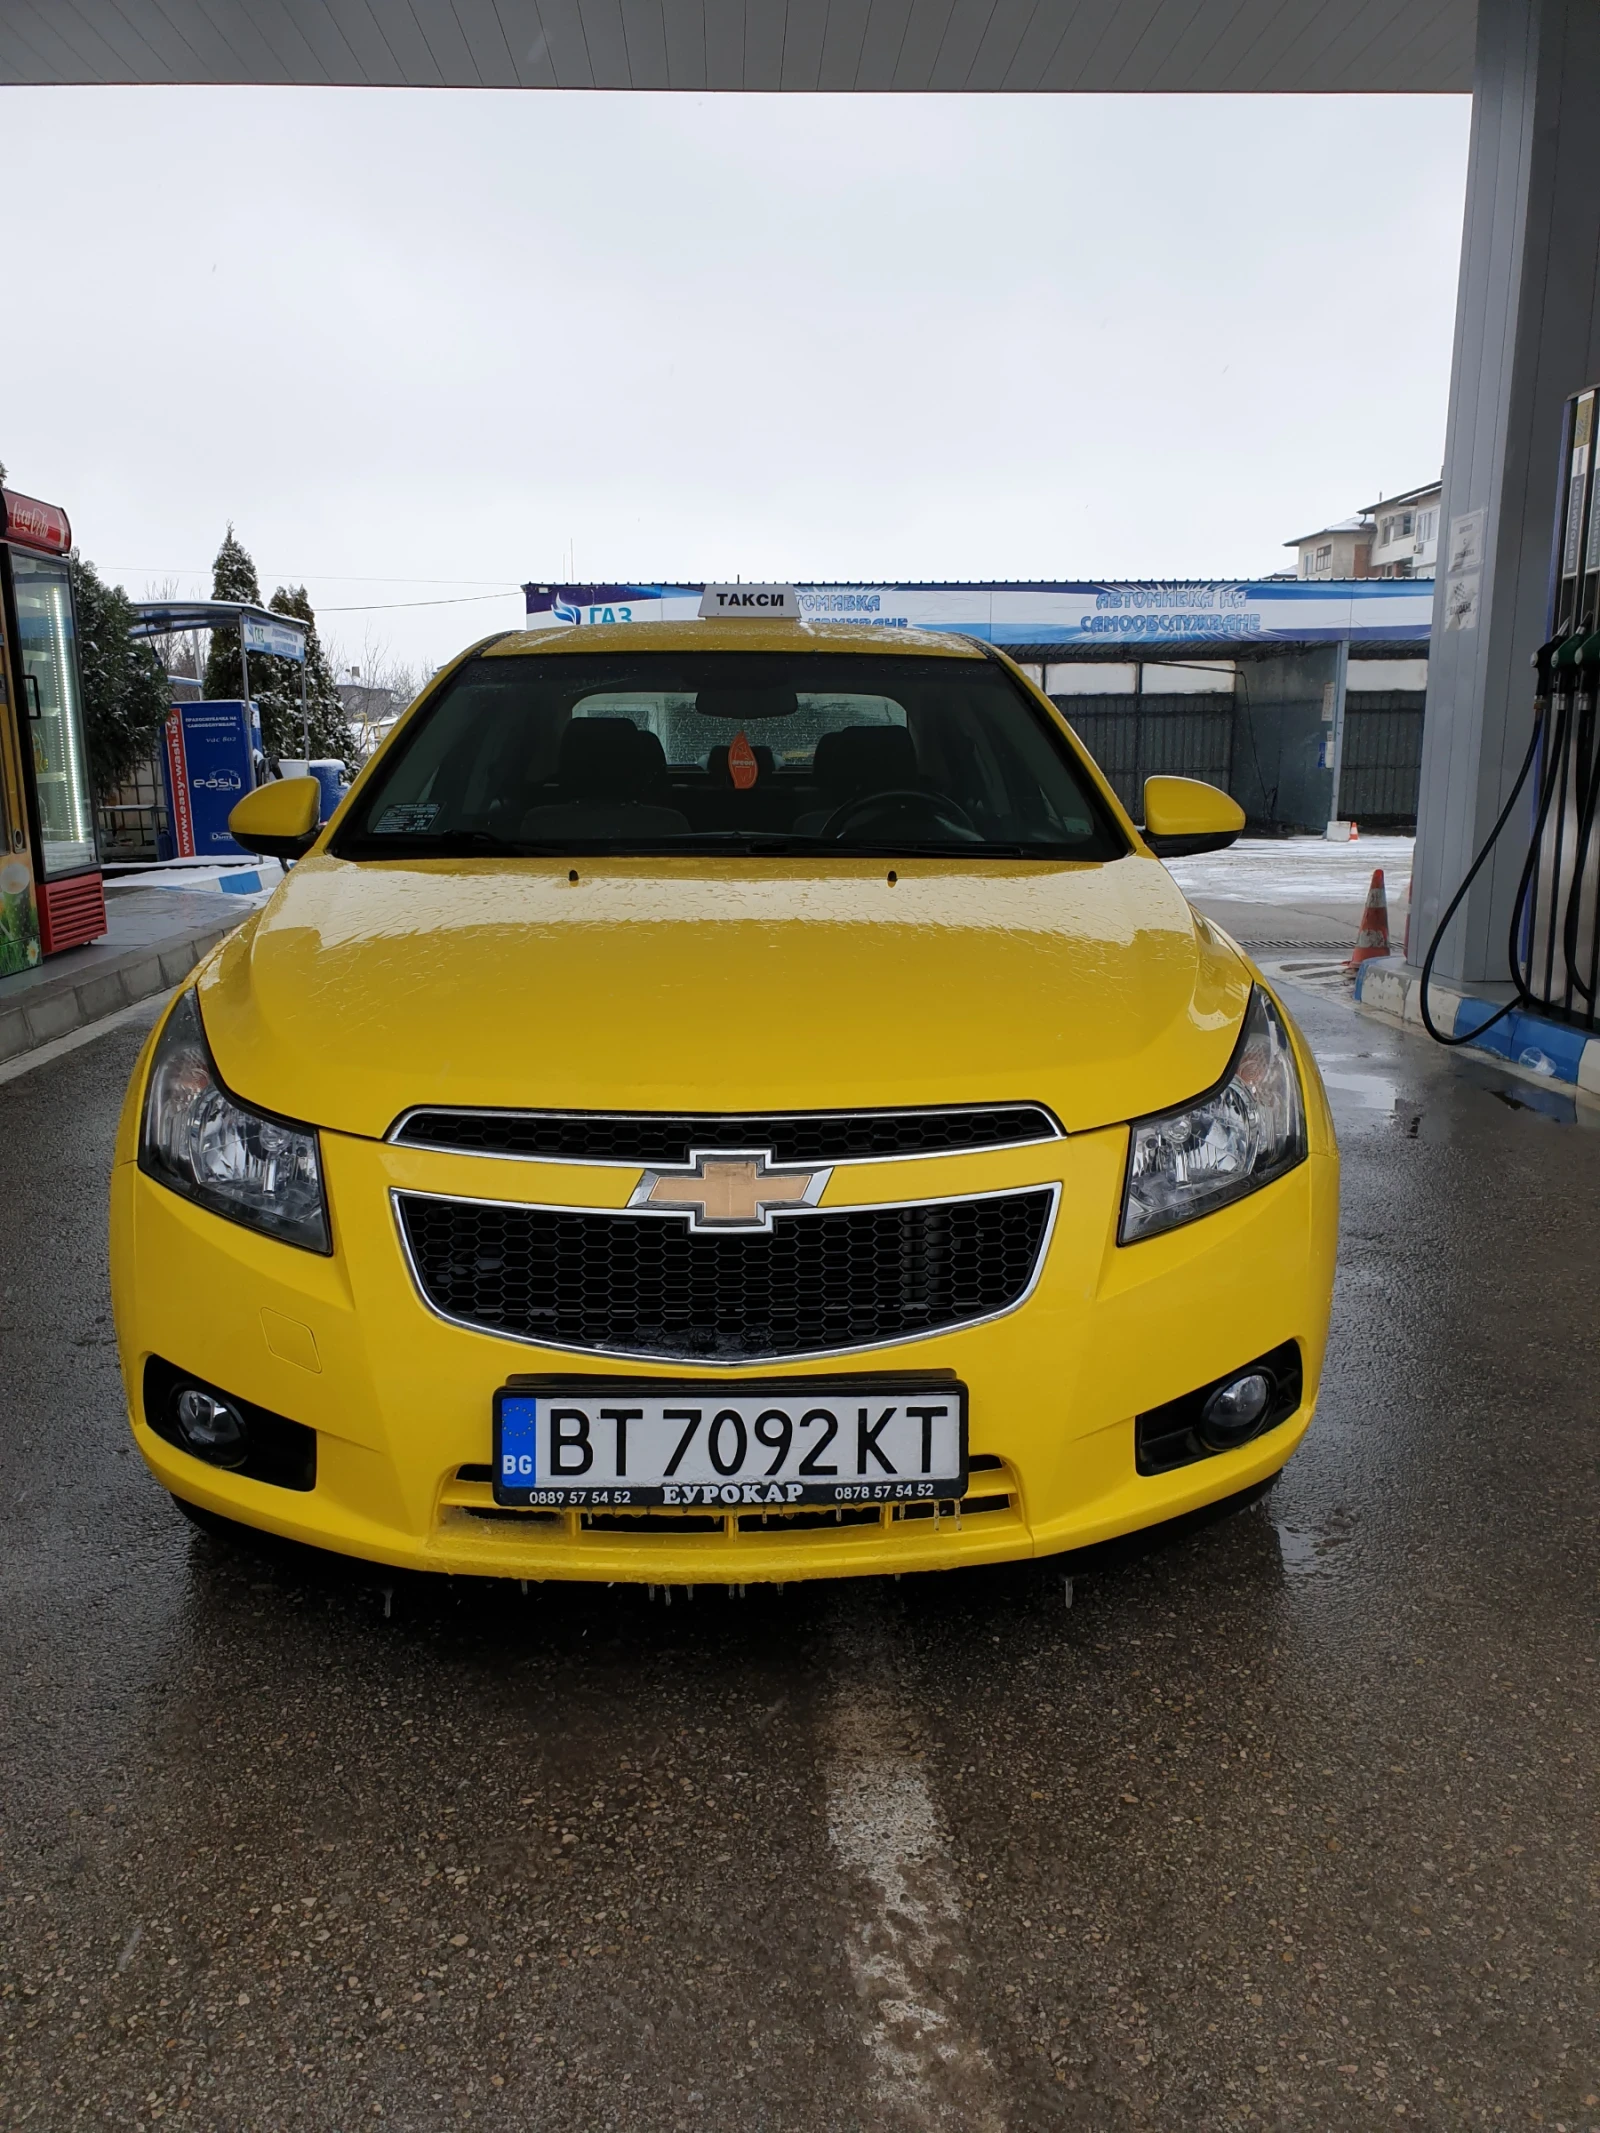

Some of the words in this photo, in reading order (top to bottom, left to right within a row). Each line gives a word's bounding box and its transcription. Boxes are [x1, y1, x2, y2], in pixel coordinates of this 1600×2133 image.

[1567, 480, 1580, 569] ЕВРОДИЗЕЛ
[716, 593, 784, 606] ТАКСИ
[1096, 591, 1213, 610] АВТОМИВКА
[1220, 591, 1246, 609] НА
[590, 607, 632, 625] ГАЗ
[1081, 614, 1260, 632] САМООБСЛУЖВАНЕ
[170, 715, 190, 854] www.easy-wash.bg
[193, 777, 241, 789] easy
[550, 1408, 643, 1477] BT
[663, 1408, 838, 1477] 7092
[857, 1406, 948, 1475] KT
[502, 1454, 532, 1475] BG
[529, 1491, 564, 1504] 0889
[569, 1491, 586, 1504] 57
[591, 1491, 609, 1504] 54
[613, 1491, 631, 1504] 52
[662, 1483, 804, 1505] ЕУРОКАР
[834, 1486, 870, 1500] 0878
[874, 1485, 891, 1498] 57
[895, 1484, 912, 1497] 54
[916, 1483, 934, 1496] 52
